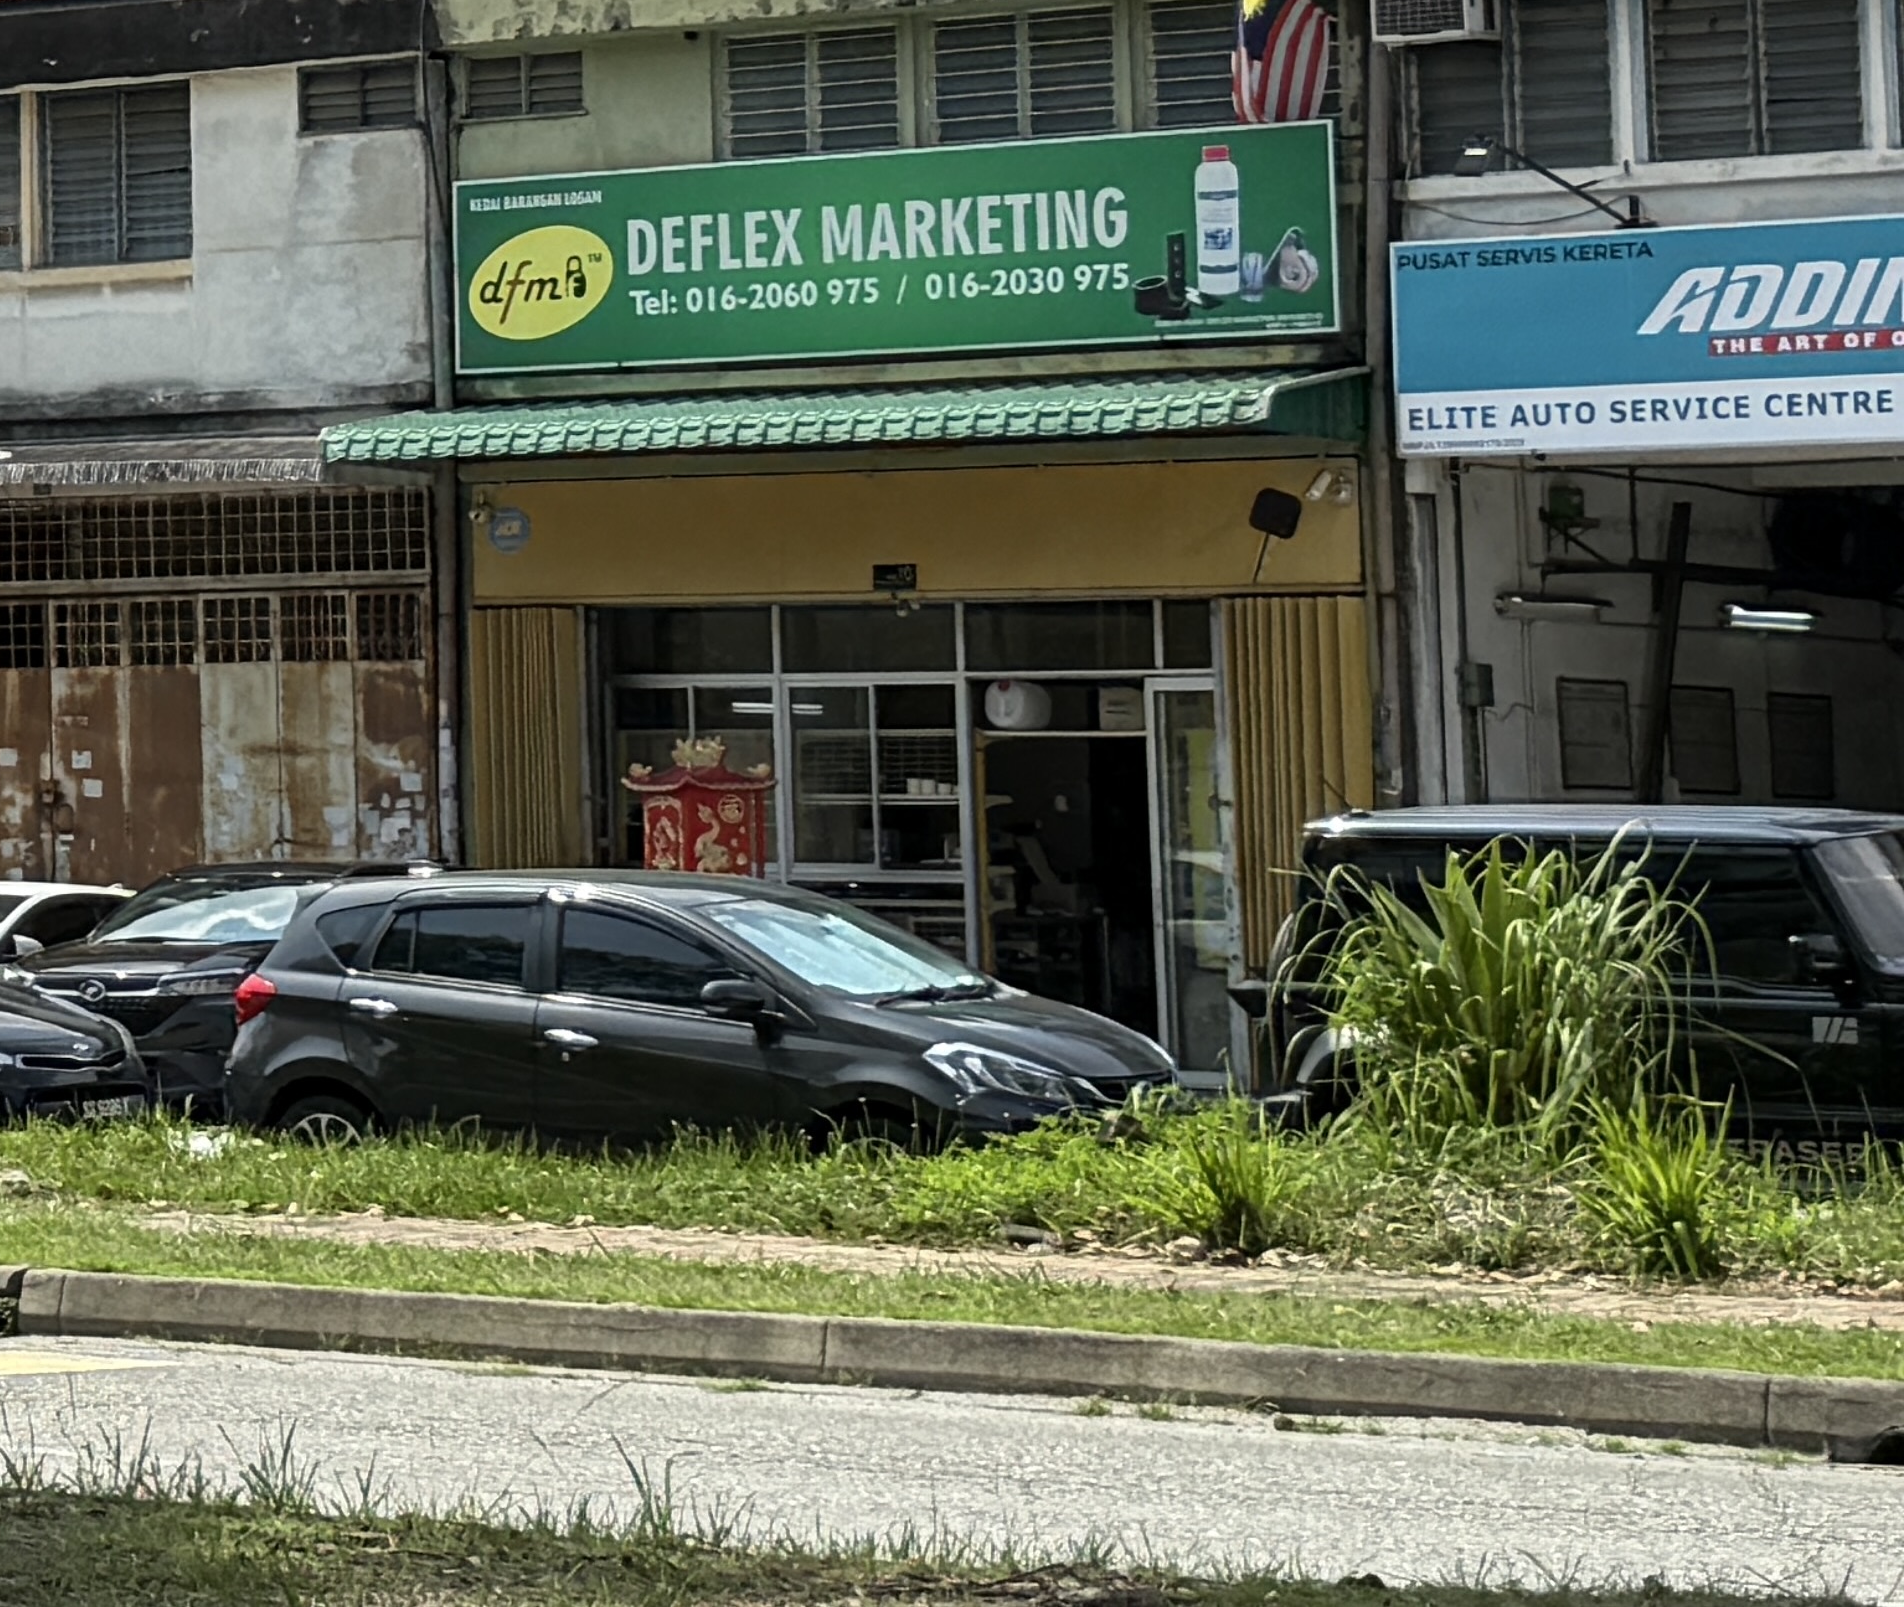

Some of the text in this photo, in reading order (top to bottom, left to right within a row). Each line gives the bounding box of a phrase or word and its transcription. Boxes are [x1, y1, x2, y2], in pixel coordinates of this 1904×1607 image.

[627, 186, 1129, 276] DEFLEX MARKETING
[1398, 241, 1654, 271] PUSAT SERVIS KERETA
[628, 288, 679, 316] Tel:
[686, 279, 818, 313] 016-2060
[826, 276, 880, 306] 975
[924, 265, 1065, 301] 016-2030
[1073, 262, 1130, 292] 975
[1711, 336, 1764, 354] THE
[1777, 333, 1829, 352] ART
[1843, 331, 1878, 349] OF
[1408, 389, 1894, 432] ELITE AUTO SERVICE CENTRE
